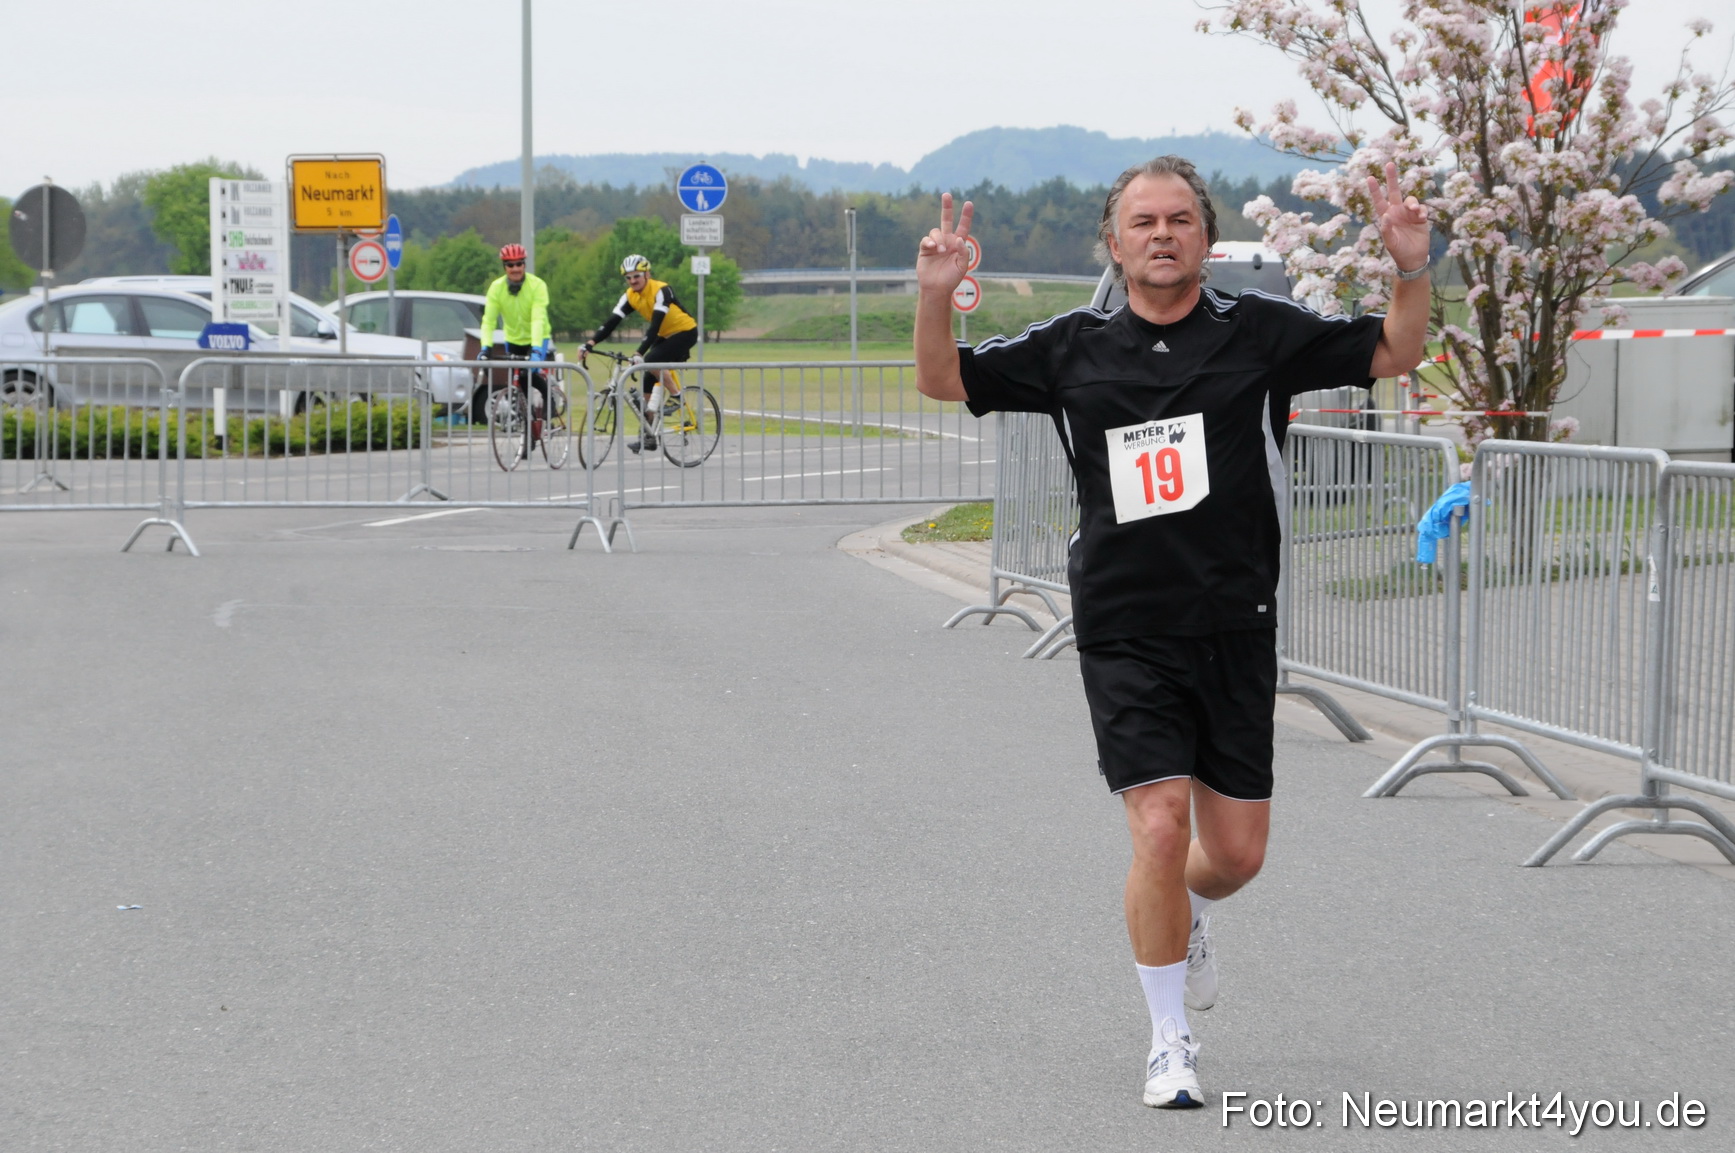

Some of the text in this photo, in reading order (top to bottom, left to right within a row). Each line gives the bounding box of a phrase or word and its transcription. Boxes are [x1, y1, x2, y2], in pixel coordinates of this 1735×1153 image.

[325, 171, 350, 179] Nach
[301, 185, 374, 201] Neumarkt
[326, 207, 352, 217] 5 km
[208, 334, 246, 349] VOLVO
[1123, 426, 1165, 443] MEYER
[1124, 436, 1166, 450] WERBUNG
[1135, 447, 1184, 505] 19
